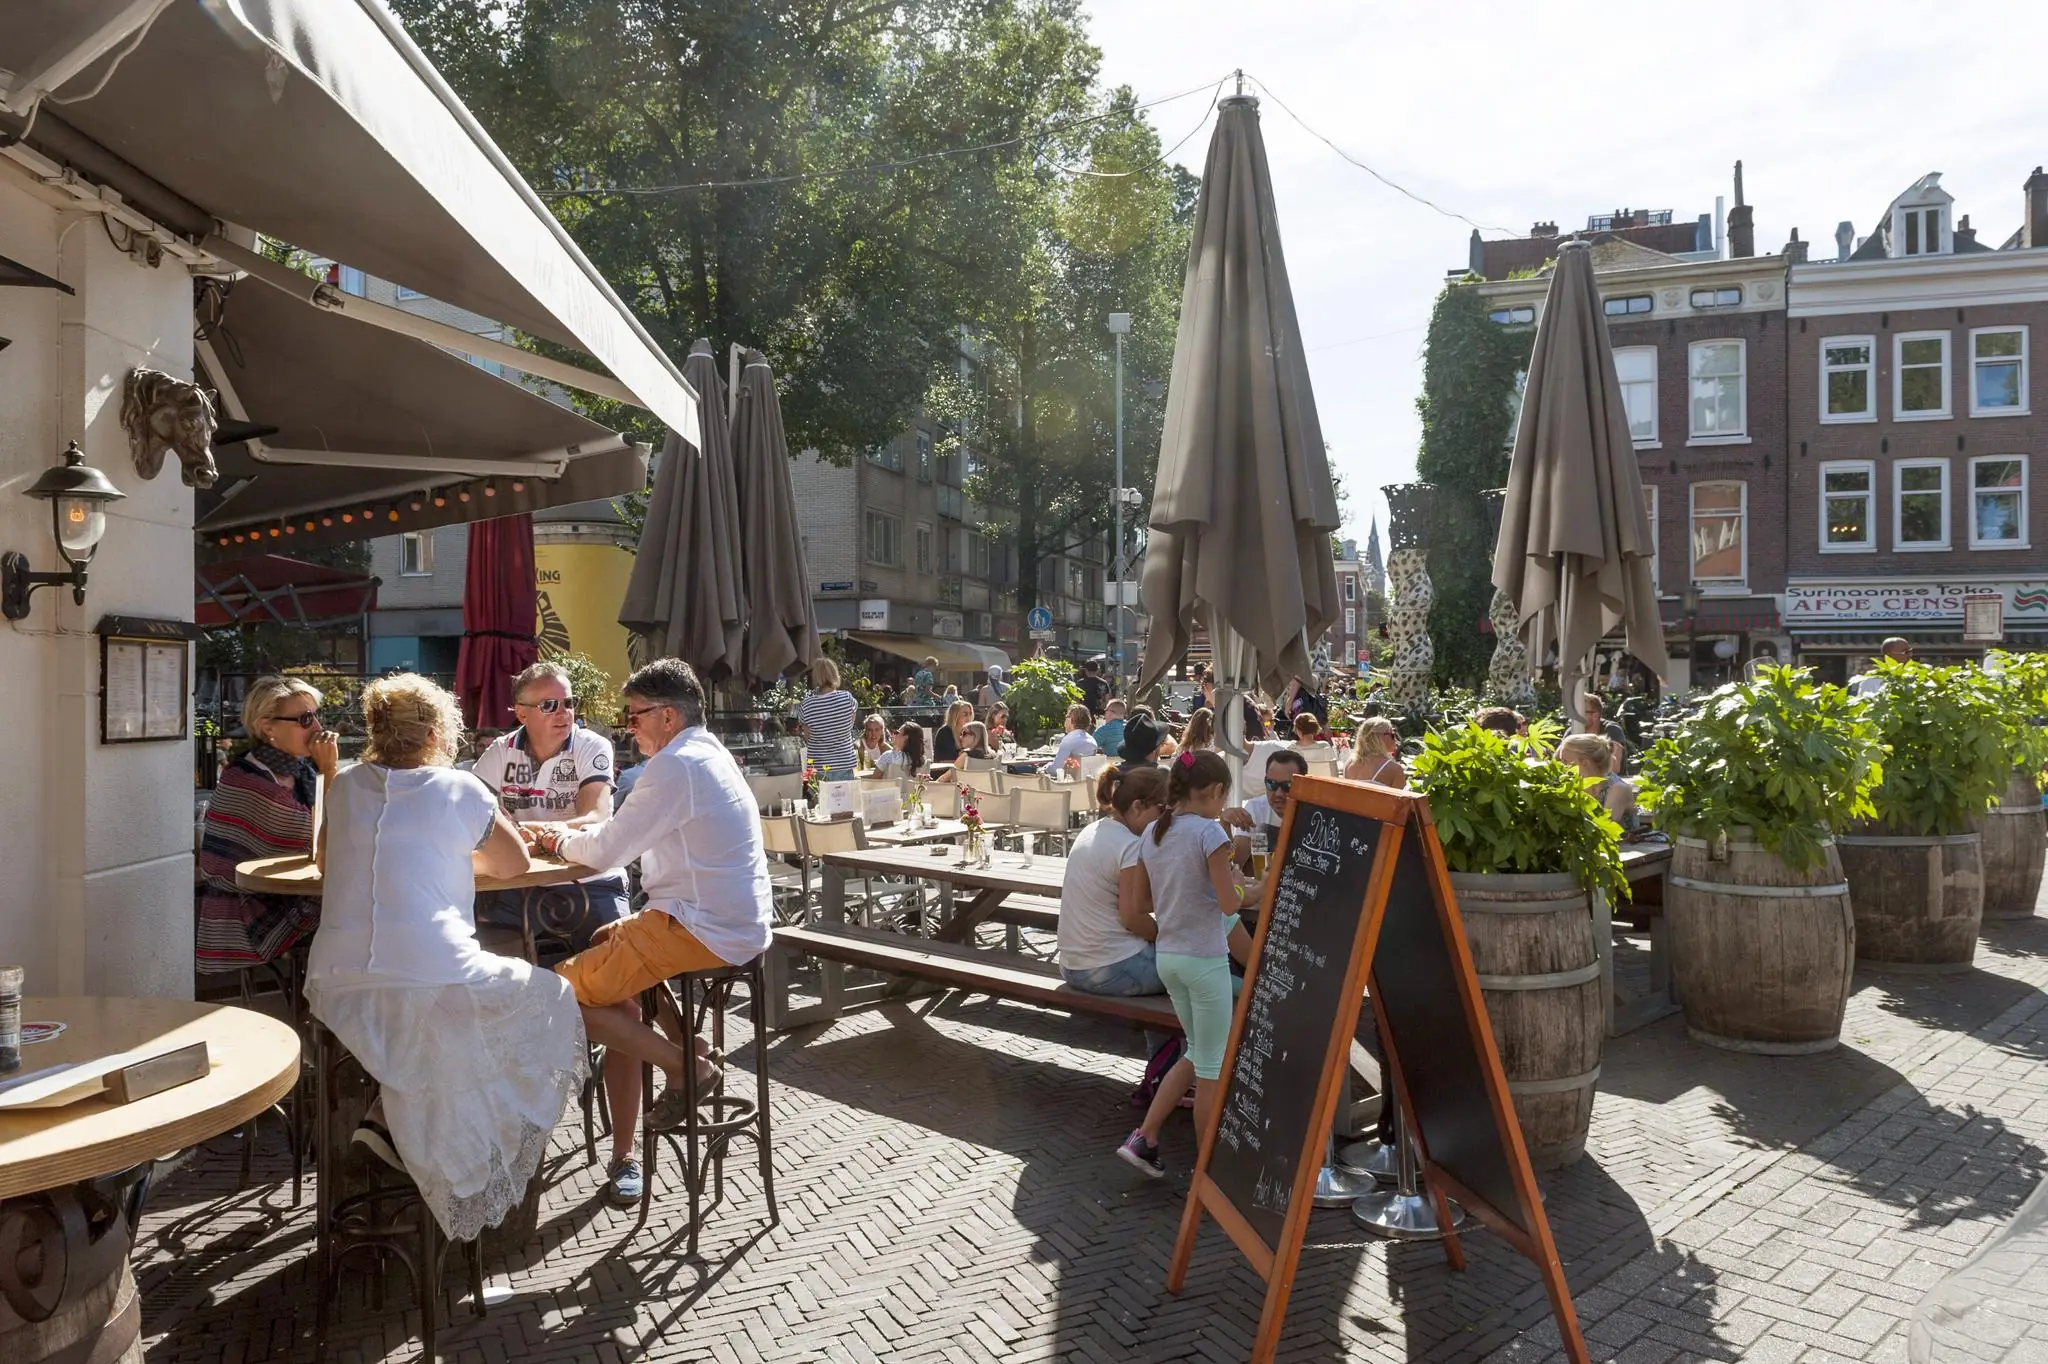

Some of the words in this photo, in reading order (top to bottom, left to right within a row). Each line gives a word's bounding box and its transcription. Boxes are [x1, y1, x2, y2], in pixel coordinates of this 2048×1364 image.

[536, 568, 561, 581] ING
[1787, 587, 1930, 598] Surinaamse
[1938, 585, 1995, 595] Toko
[1791, 599, 1872, 611] AFOE
